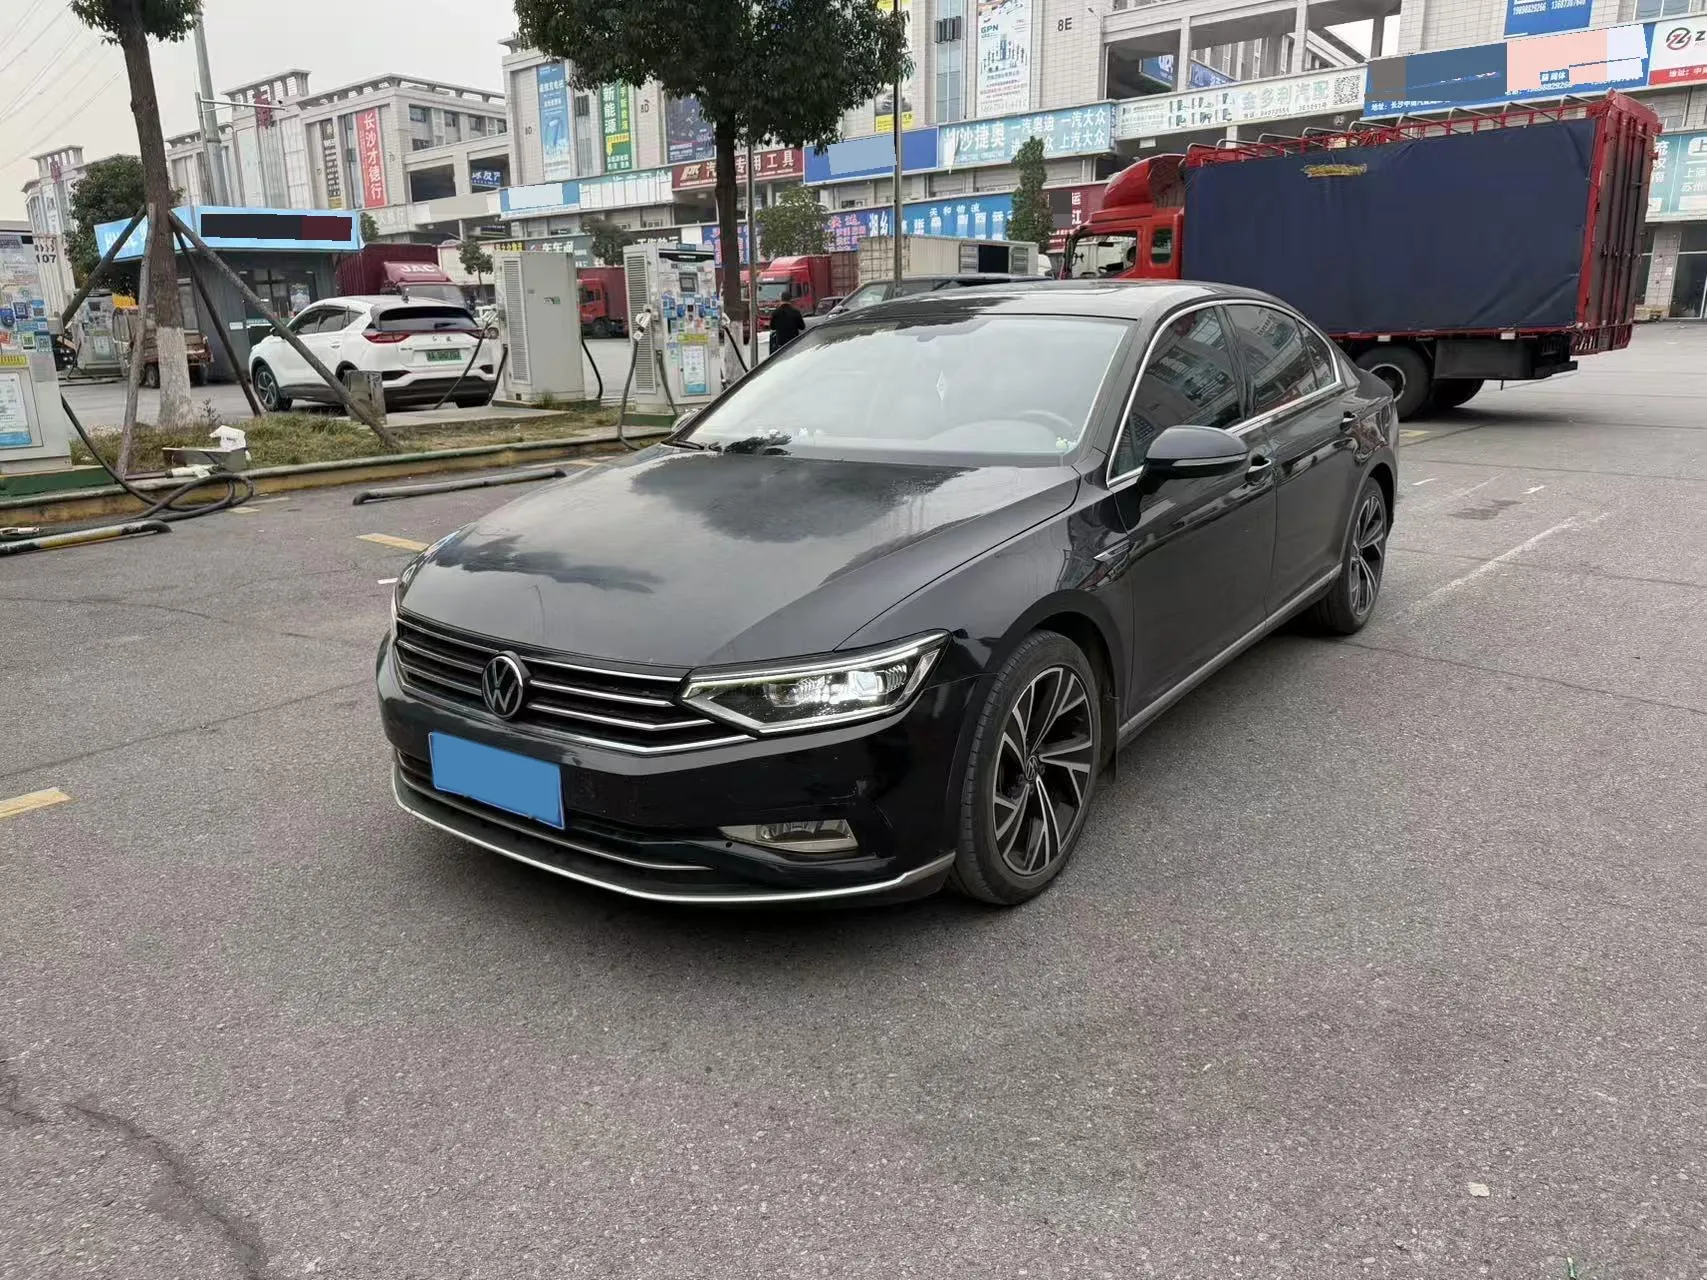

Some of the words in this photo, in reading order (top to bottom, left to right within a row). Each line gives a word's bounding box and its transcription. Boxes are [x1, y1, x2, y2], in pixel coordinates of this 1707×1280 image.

[980, 24, 999, 34] GPN
[1057, 17, 1072, 31] 8E
[1011, 116, 1055, 133] 一汽奥迪
[1061, 107, 1106, 128] 一汽大众
[1059, 129, 1105, 150] 上汽大众
[401, 264, 436, 273] JAC
